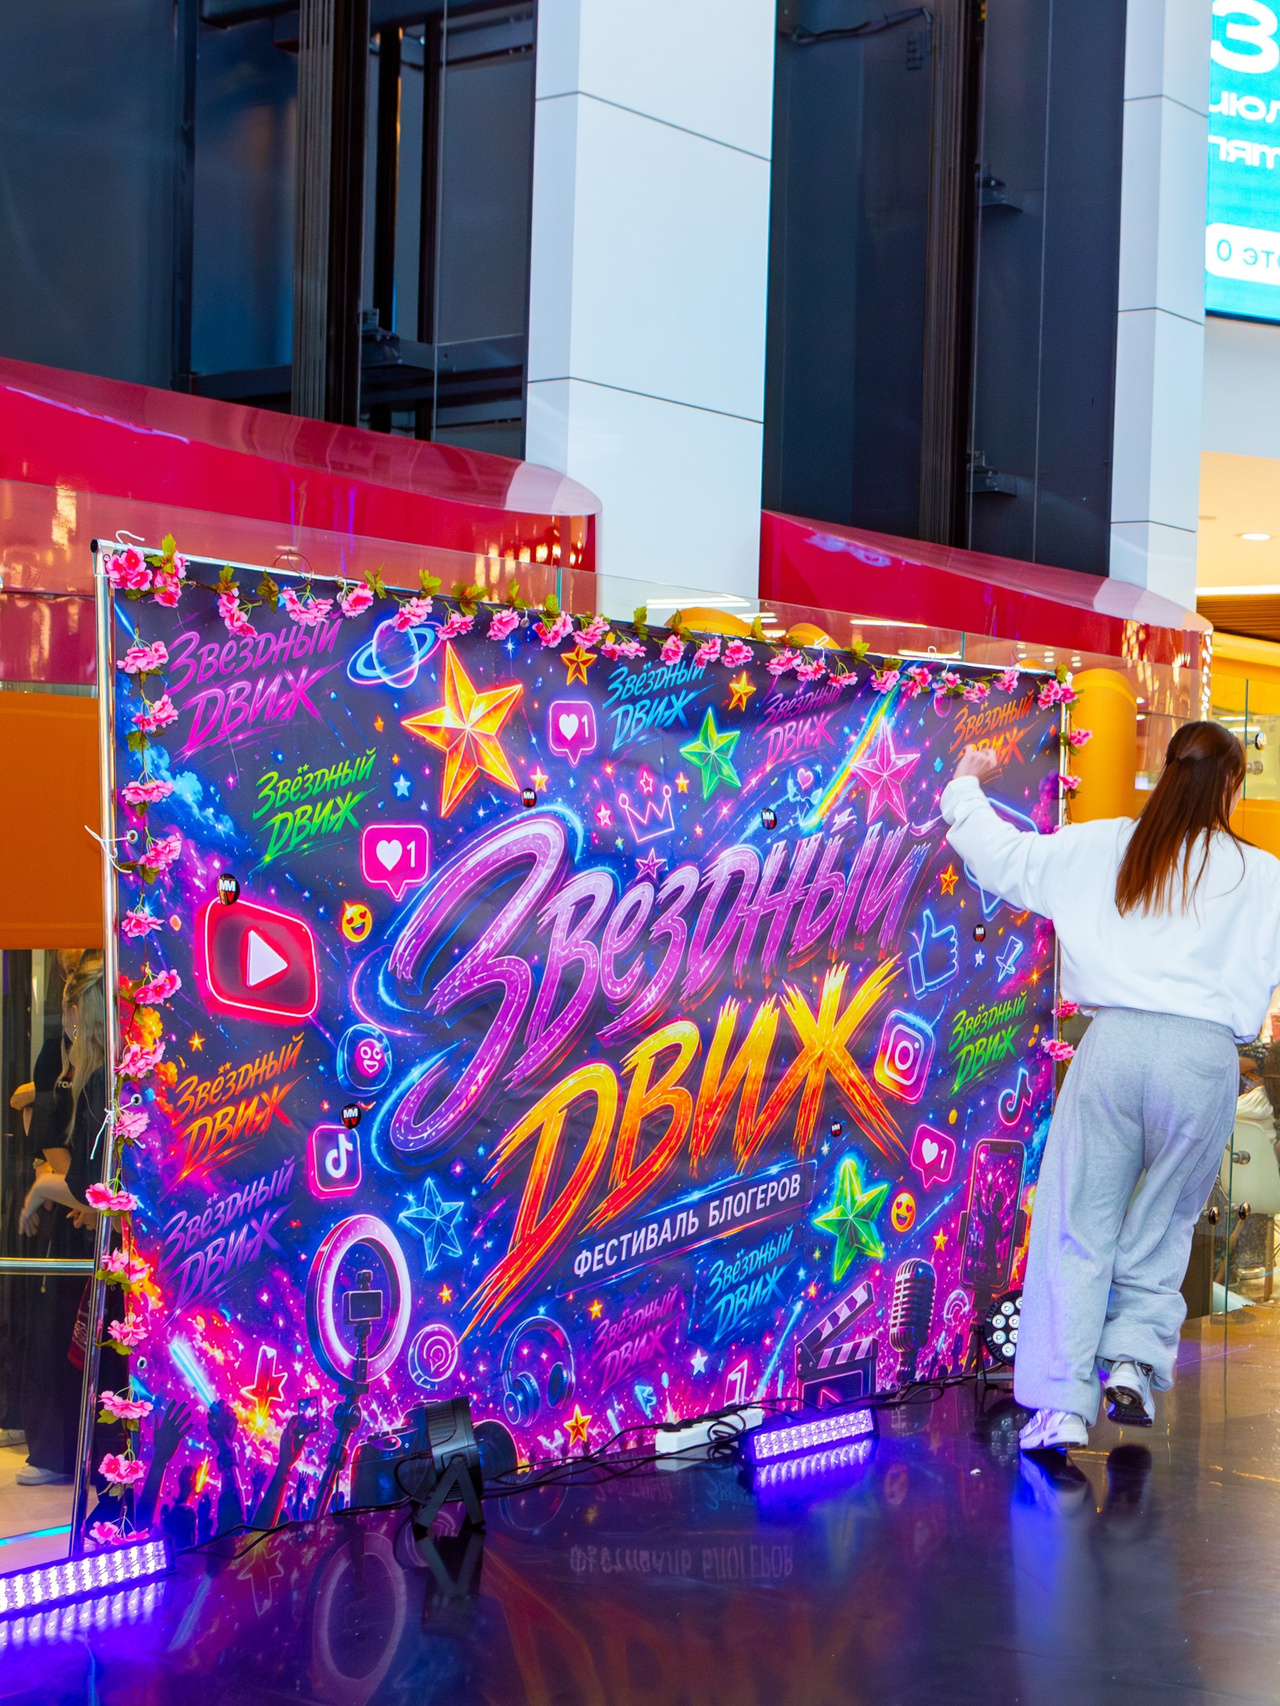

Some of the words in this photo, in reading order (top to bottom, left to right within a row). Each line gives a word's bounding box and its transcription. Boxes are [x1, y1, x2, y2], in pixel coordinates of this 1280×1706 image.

[1211, 0, 1280, 74] 3
[1216, 239, 1233, 262] 0
[574, 1209, 699, 1278] ФЕСТИВАЛЬ
[708, 1173, 801, 1228] БЛОГЕРОВ
